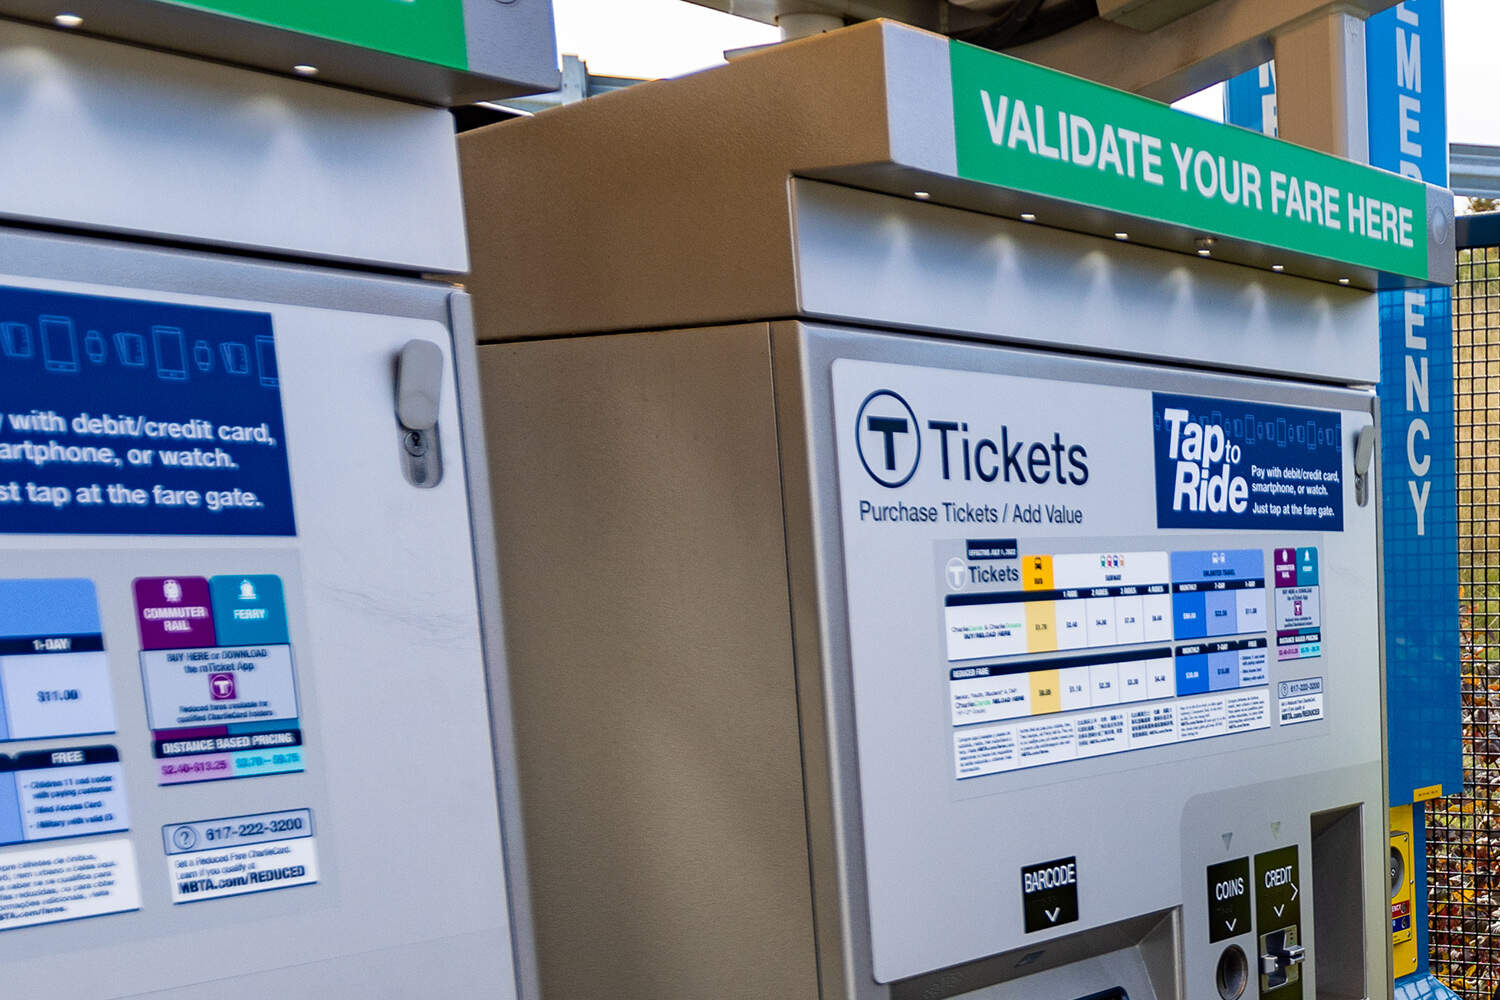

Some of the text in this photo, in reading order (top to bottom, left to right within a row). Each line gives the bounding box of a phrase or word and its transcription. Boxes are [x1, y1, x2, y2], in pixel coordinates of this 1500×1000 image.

[980, 89, 1414, 248] VALIDATE YOUR FARE HERE
[8, 410, 67, 432] with
[71, 411, 213, 440] debit/credit
[217, 423, 276, 445] card,
[1164, 407, 1241, 468] Tap to
[127, 448, 152, 466] or
[159, 448, 239, 468] watch.
[928, 420, 1089, 486] Tickets
[1251, 465, 1340, 484] Pay with debit/credit card,
[26, 481, 71, 507] tap
[76, 483, 103, 503] at
[107, 484, 148, 505] the
[152, 485, 200, 506] fare
[206, 488, 263, 511] gate.
[1172, 460, 1249, 514] Ride
[1251, 483, 1328, 496] smartphone, or watch.
[859, 499, 938, 523] Purchase
[942, 501, 998, 524] Tickets
[1012, 504, 1042, 524] Add
[1045, 504, 1083, 524] Value
[1252, 503, 1335, 518] Just tap at the fare gate.
[968, 565, 1019, 583] Tickets
[143, 606, 206, 619] COMMUTER
[234, 609, 265, 619] FERRY
[164, 620, 190, 631] RAIL
[33, 638, 70, 651] 1-DAY
[187, 651, 209, 661] HERE
[221, 649, 267, 660] DOWNLOAD
[237, 662, 254, 672] App
[37, 689, 79, 703] $11.00
[162, 732, 294, 754] DISTANCE BASED PRICING
[51, 751, 84, 764] FREE
[205, 817, 302, 841] 617-222-3200
[177, 865, 305, 895] MBTA.com/REDUCED
[1024, 863, 1076, 893] BARCODE
[1265, 865, 1293, 889] CREDIT
[1216, 877, 1245, 901] COINS
